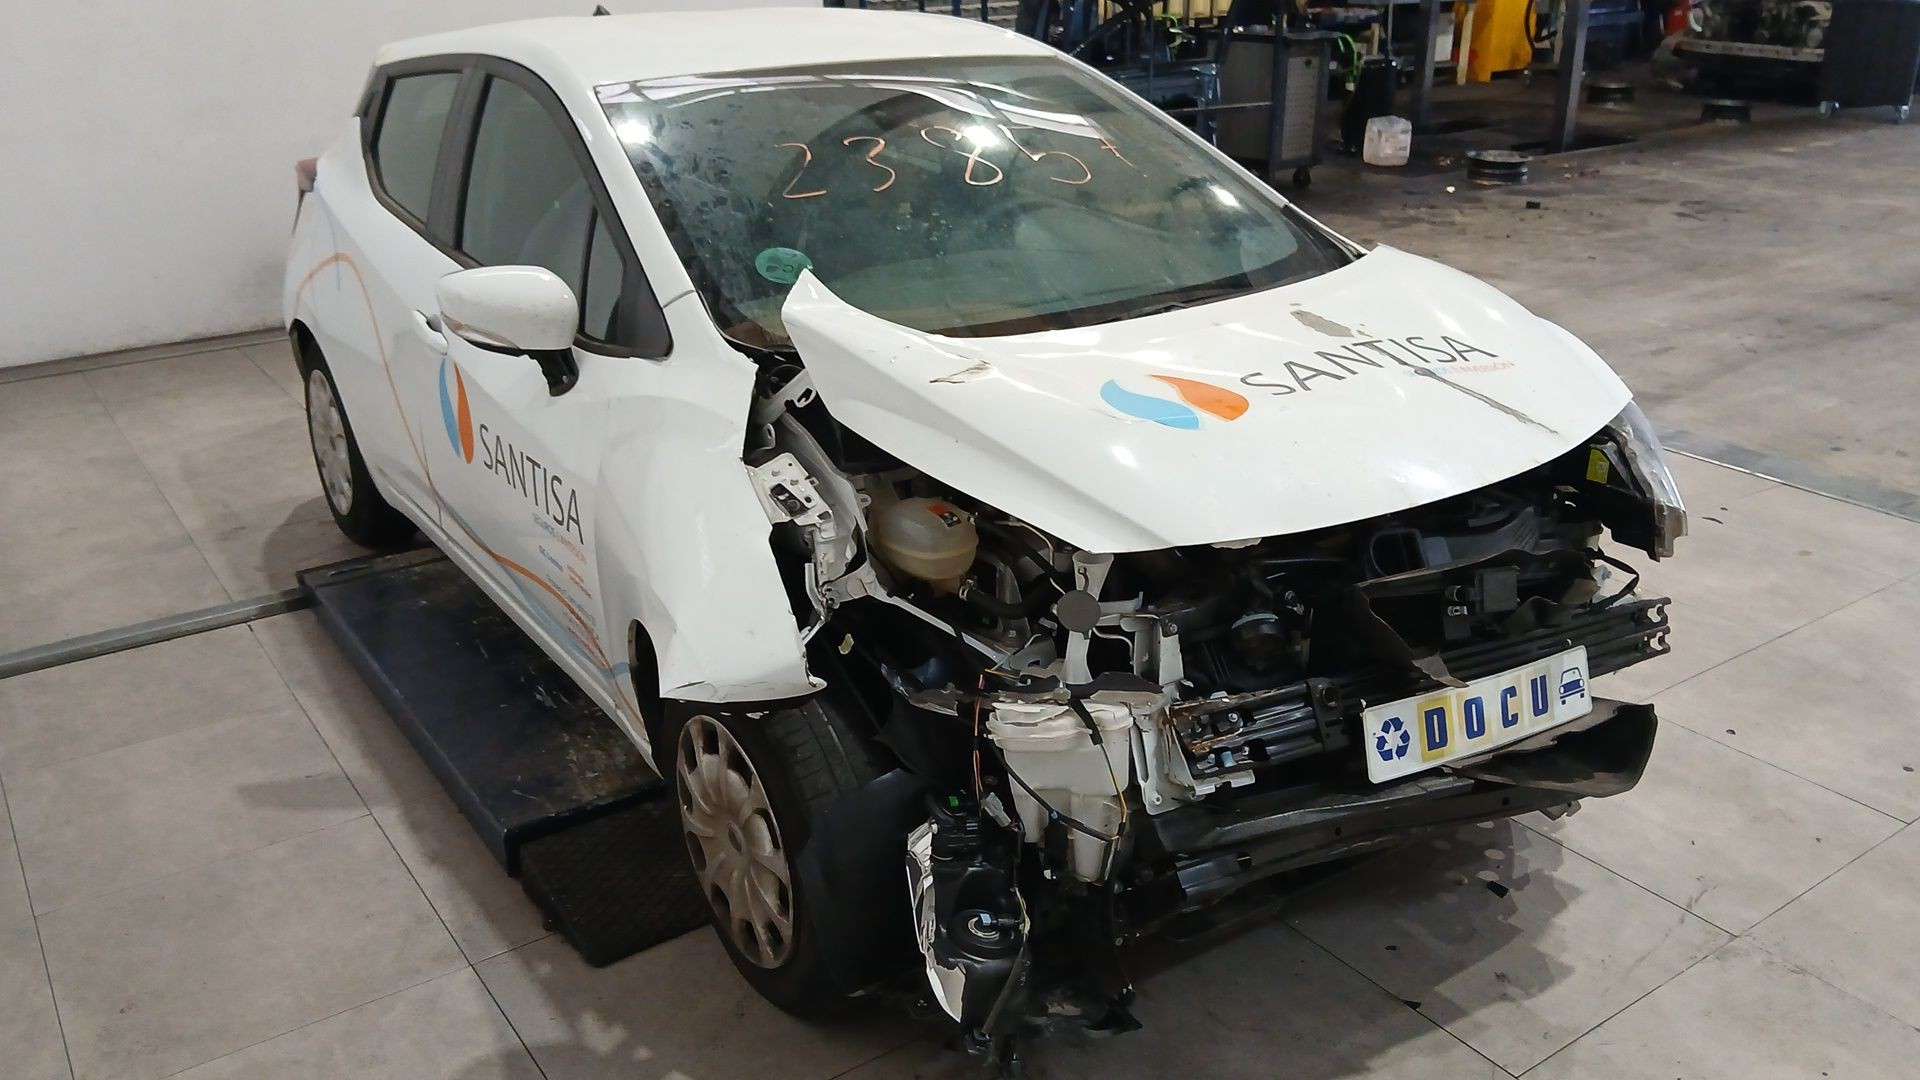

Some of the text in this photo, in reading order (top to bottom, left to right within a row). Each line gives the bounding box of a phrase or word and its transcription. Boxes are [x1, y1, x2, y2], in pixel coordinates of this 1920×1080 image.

[1240, 335, 1498, 396] SANTISA
[479, 423, 584, 545] SANTISA
[1424, 674, 1549, 752] DOCU
